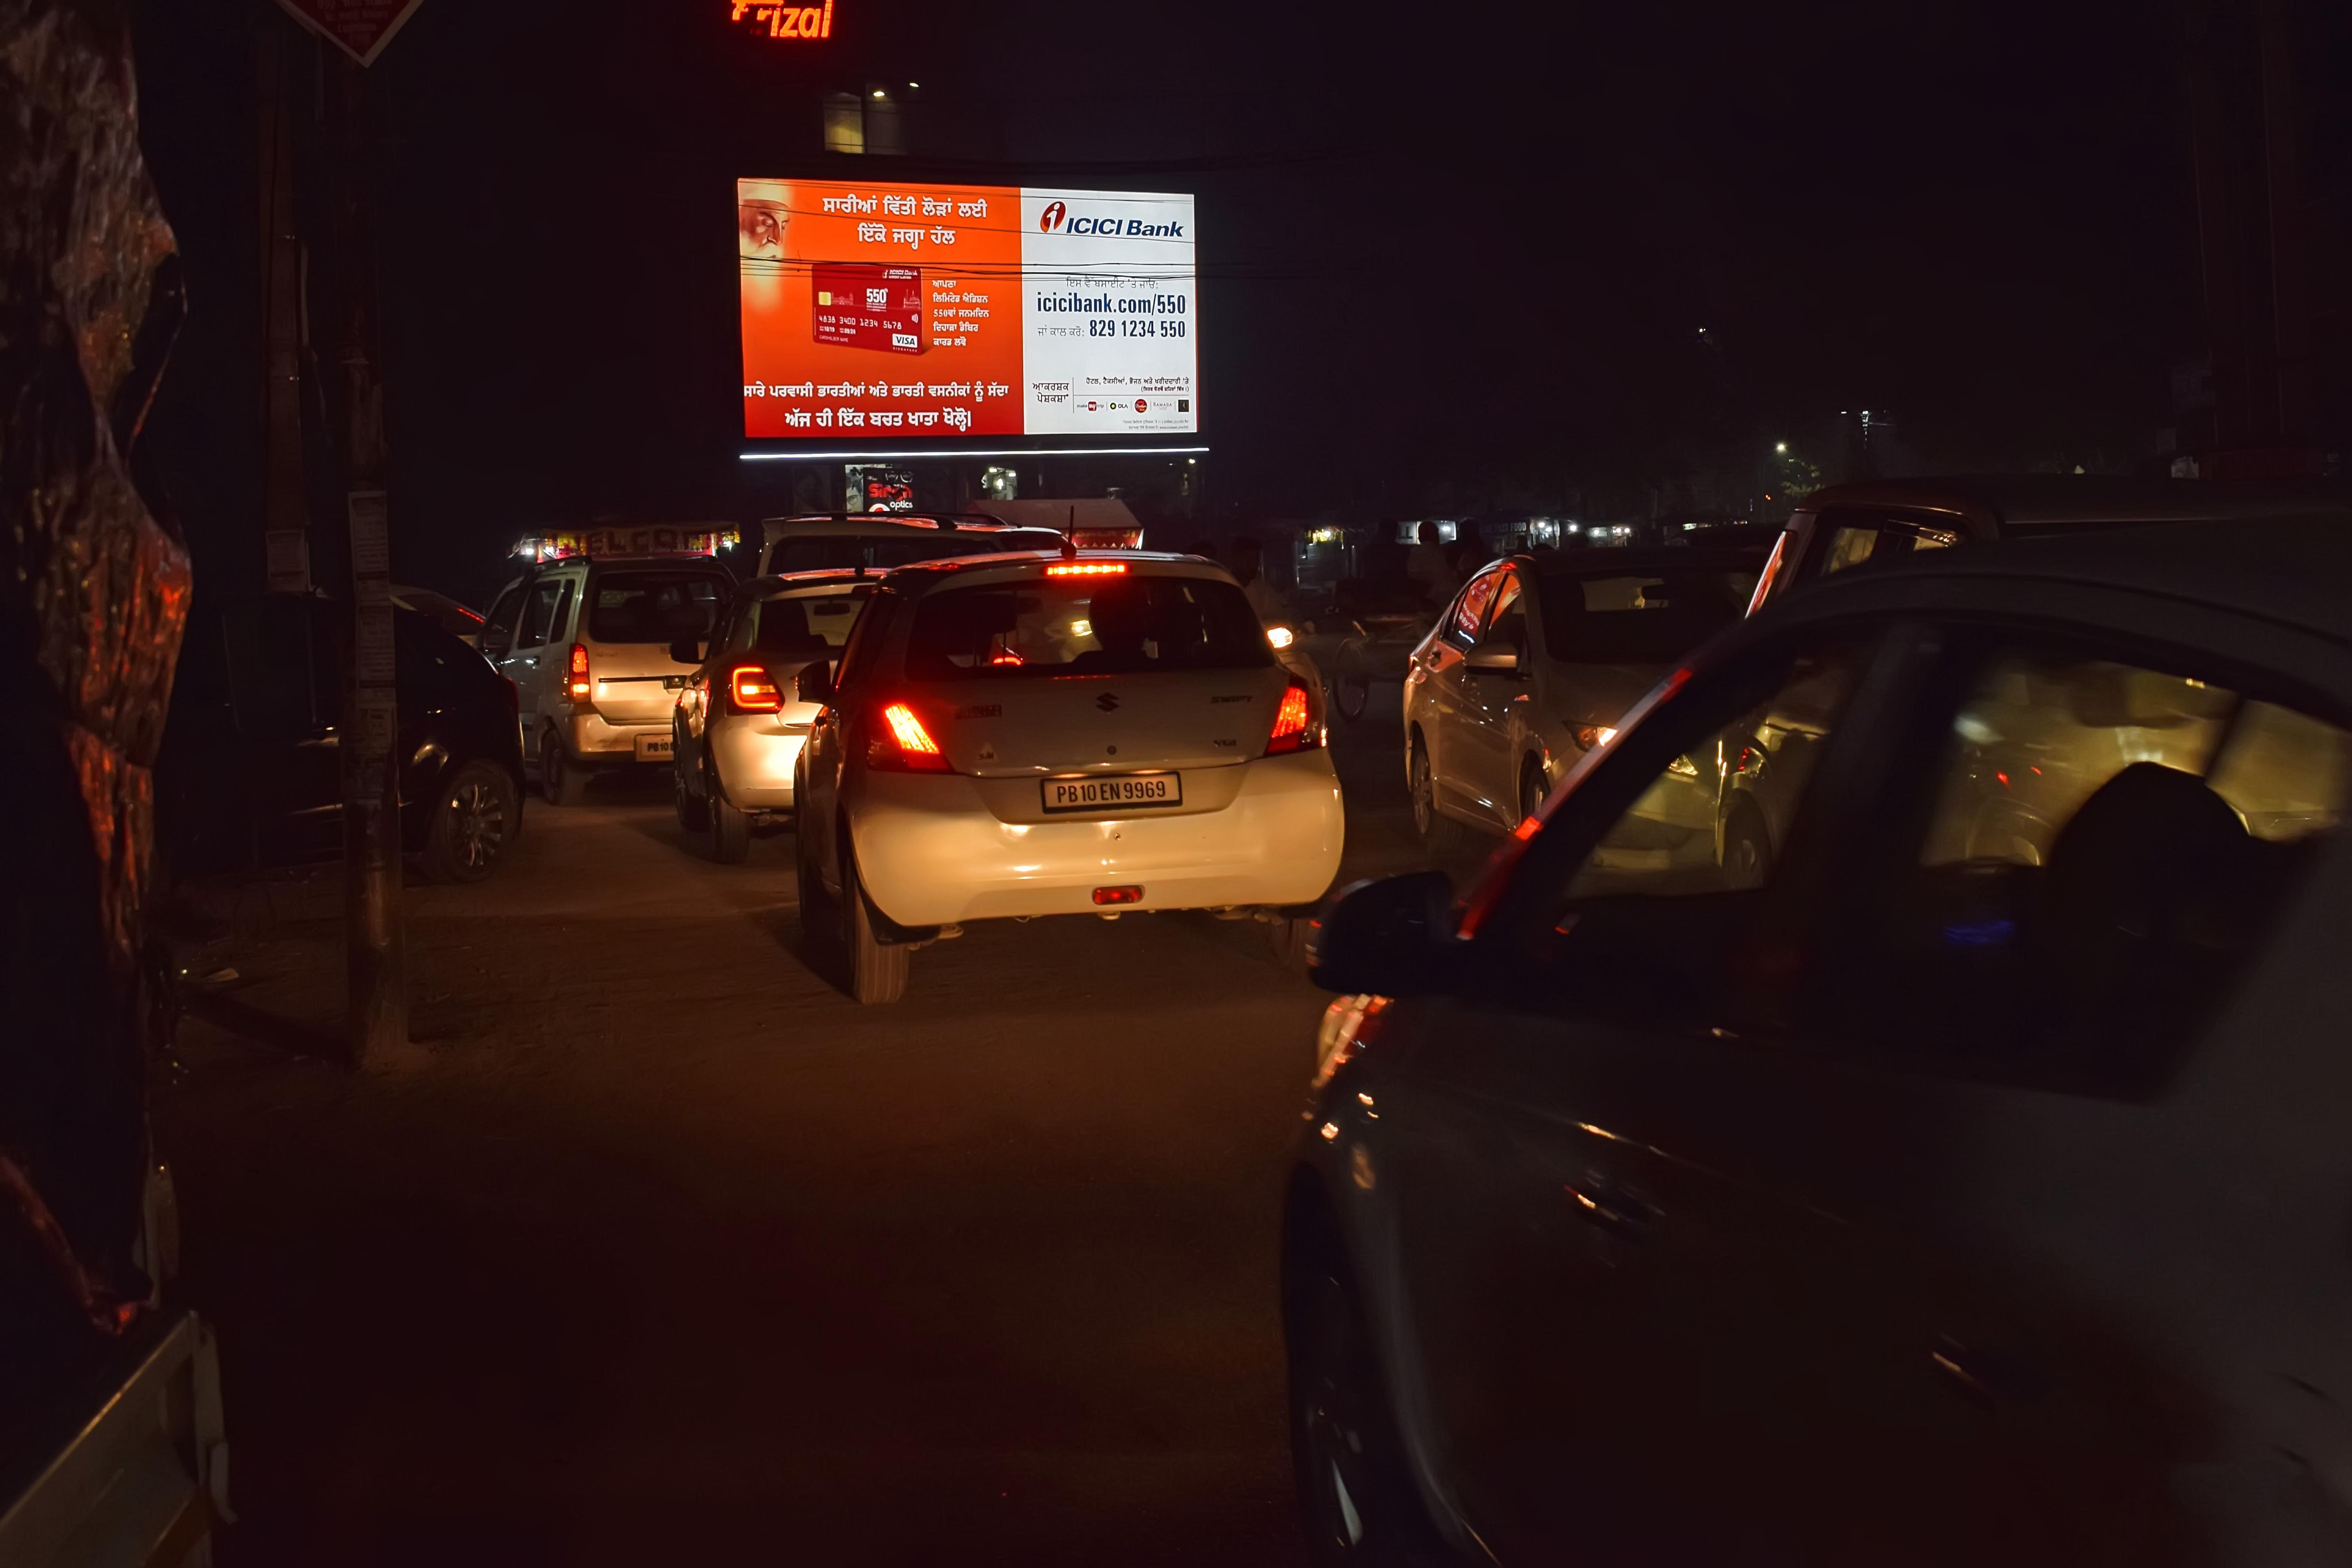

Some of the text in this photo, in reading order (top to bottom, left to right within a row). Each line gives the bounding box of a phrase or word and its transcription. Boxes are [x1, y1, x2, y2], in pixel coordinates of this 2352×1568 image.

[823, 194, 987, 218] ਸਾਰੀਆਂ ਵਿੱਤੀ ਲੋੜਾਂ ਲਈ
[857, 222, 887, 242] ਇੱਕੋ
[930, 226, 955, 244] ਹੱਲ
[1066, 218, 1184, 237] ICICI Bank
[958, 307, 989, 317] ਜਨਮਦਿਨ
[1038, 292, 1185, 315] icicibank.com/550
[819, 315, 902, 329] 4838 3400 1234 5678
[1038, 325, 1047, 336] ਜਾਂ
[1050, 328, 1066, 337] ਕਾਲ
[1090, 319, 1115, 337] 829
[1121, 320, 1155, 337] 1234
[1160, 321, 1185, 338] 550
[895, 336, 915, 345] VISA
[744, 381, 1009, 402] ਸਾਰੇ ਪਰਵਾਸੀ ਭਾਰਤੀਆਂ ਅਤੇ ਭਾਰਤੀ ਵਸਨੀਕਾਂ ਨੂੰ ਸੱਦਾ
[785, 408, 811, 427] ਅੱਜ
[816, 408, 833, 426] ਹੀ
[837, 408, 865, 427] ਇੱਕ
[869, 412, 903, 426] ਬਚਤ
[907, 412, 939, 426] ਖਾਤਾ
[889, 500, 913, 511] optics
[1123, 780, 1165, 799] 9969
